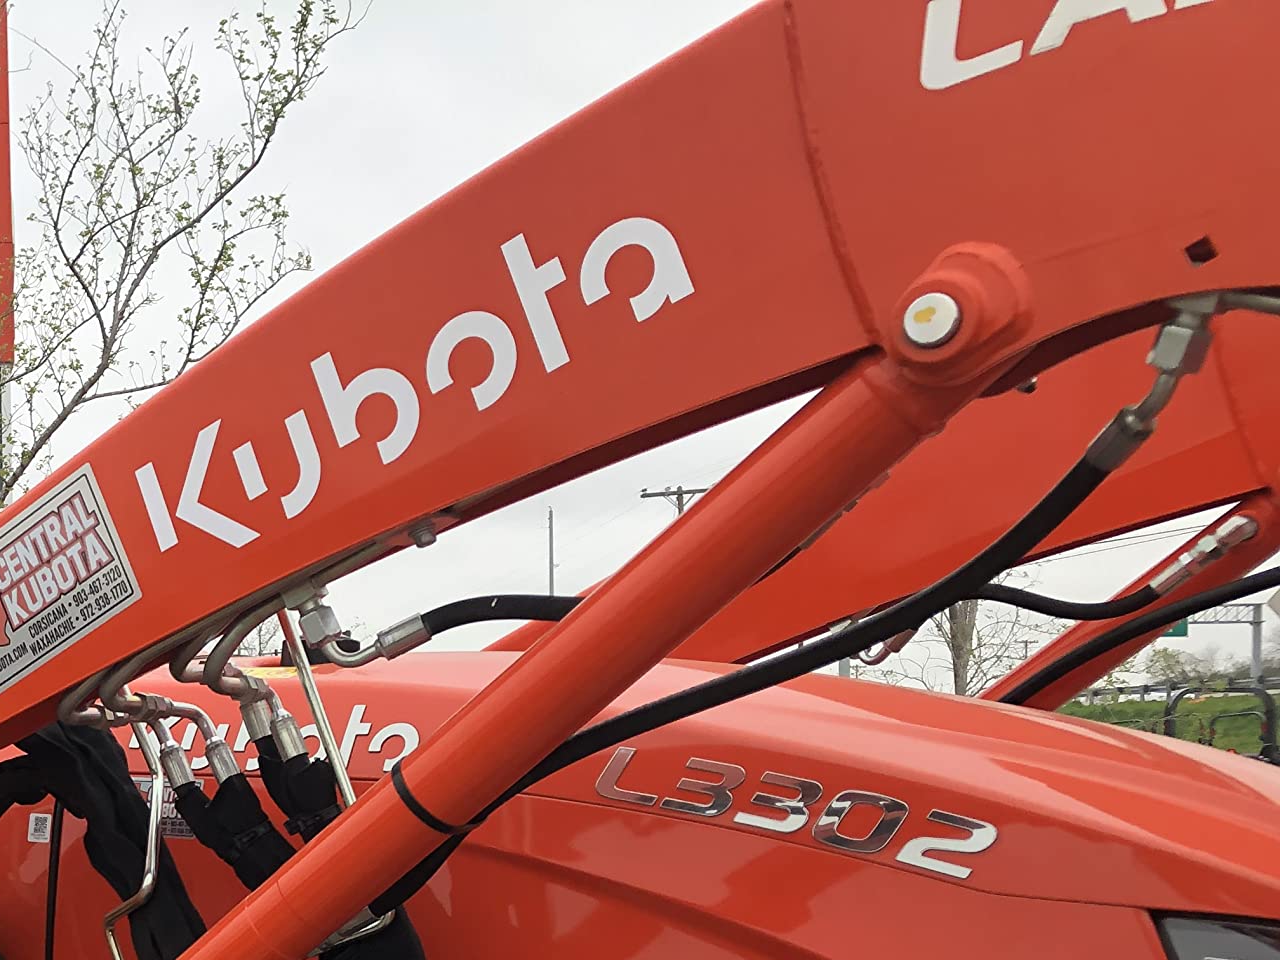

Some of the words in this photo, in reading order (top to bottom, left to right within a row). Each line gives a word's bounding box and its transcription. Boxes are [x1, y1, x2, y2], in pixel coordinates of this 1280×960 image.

[135, 217, 695, 552] Kubota
[1, 531, 114, 632] KUBOTA
[28, 603, 69, 638] CORSICANA
[72, 565, 122, 607] 903-467-3120
[29, 617, 76, 656] WAXAHACHIE
[79, 580, 128, 623] 972-938-1770
[128, 704, 420, 773] uota
[595, 746, 999, 879] L3302
